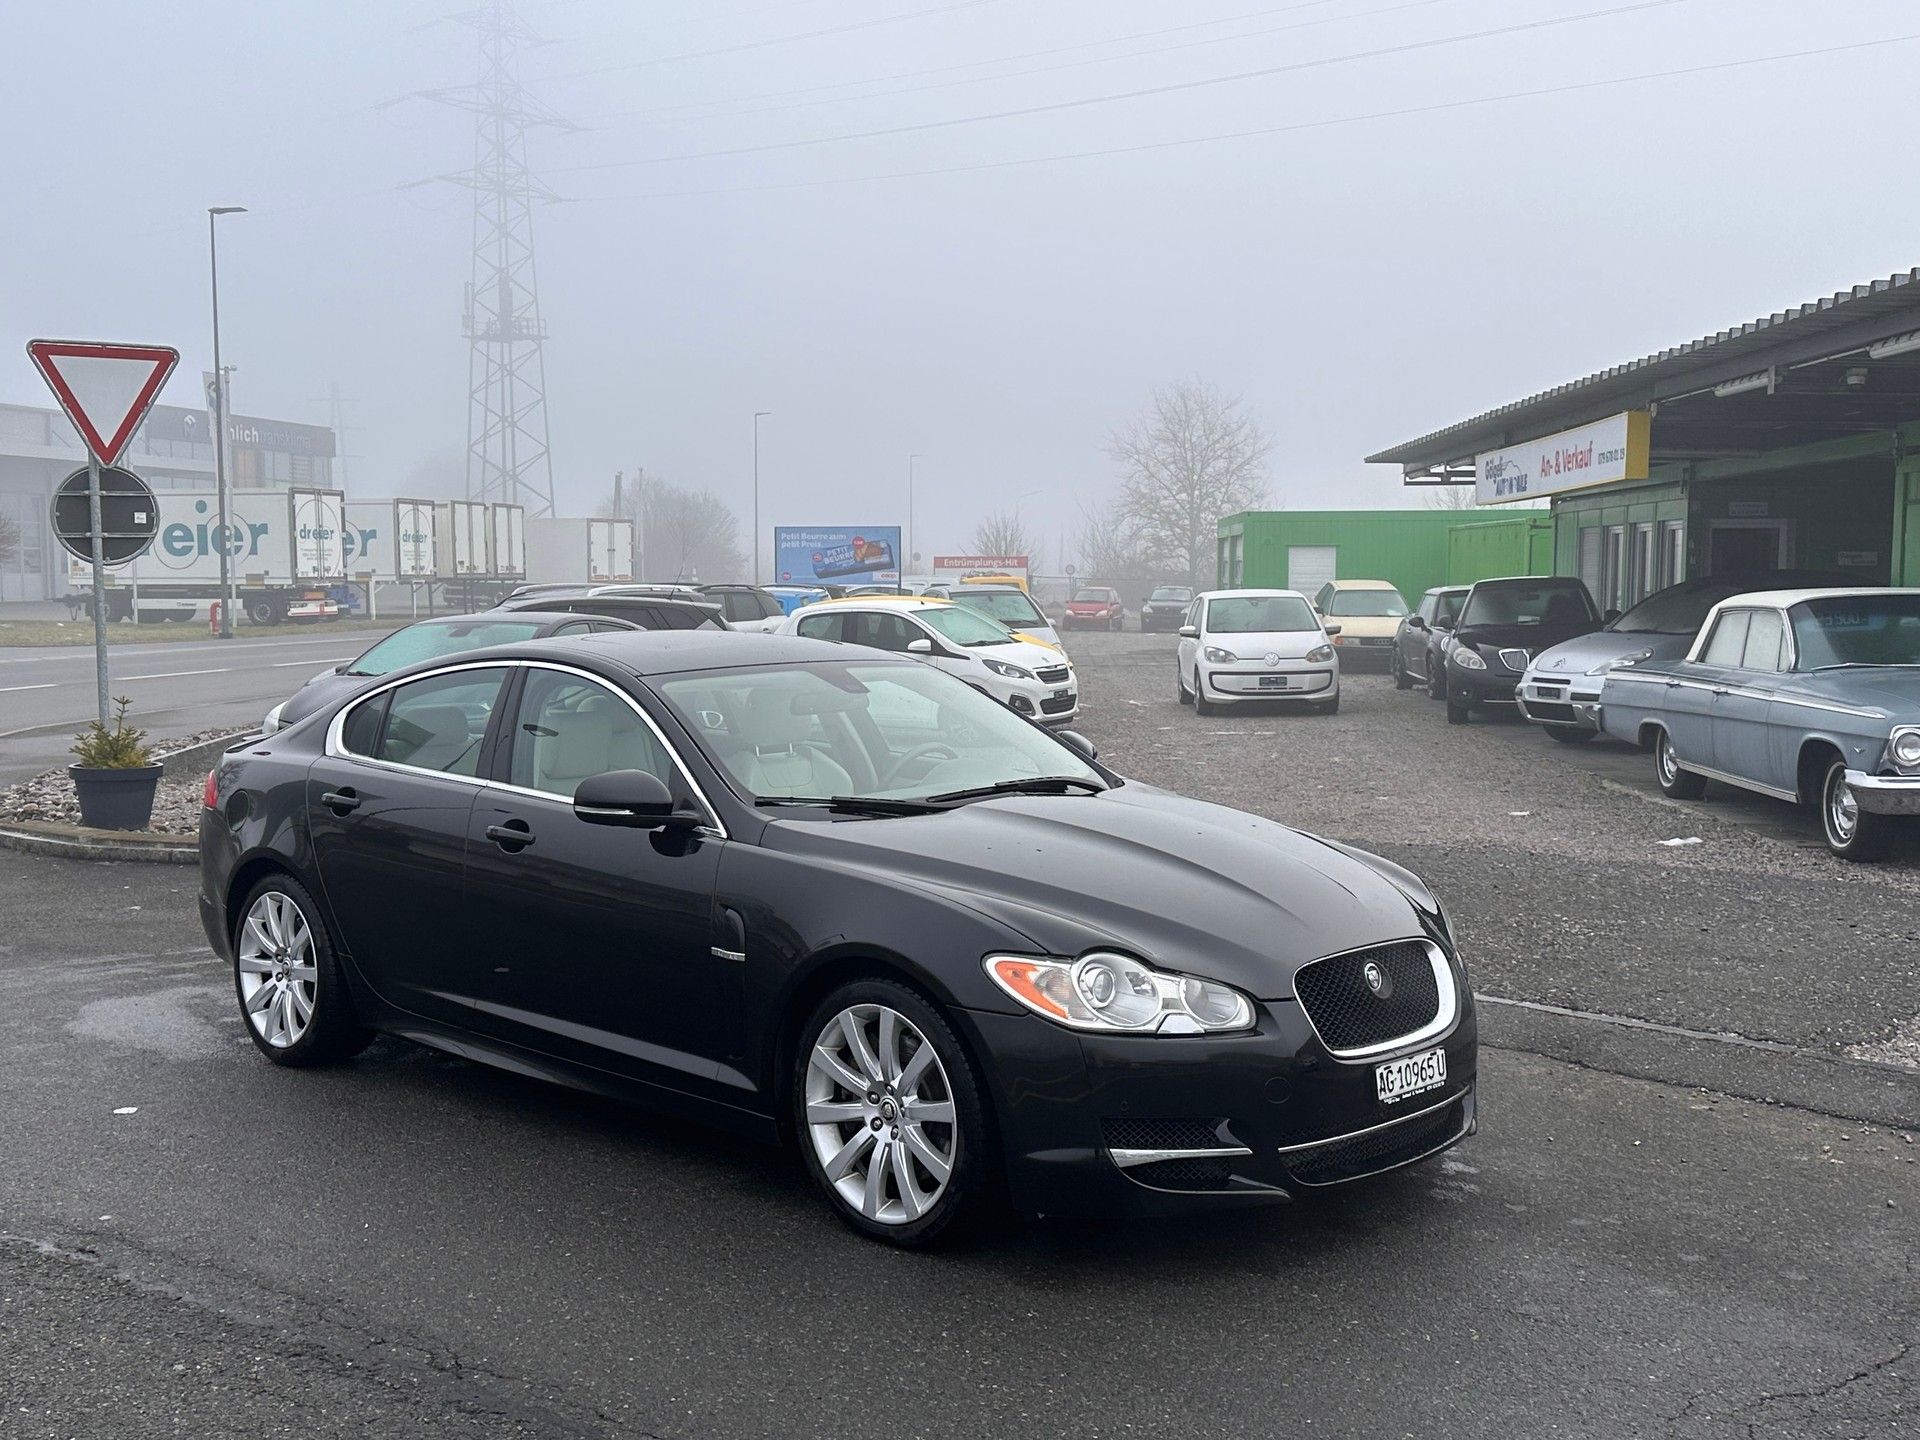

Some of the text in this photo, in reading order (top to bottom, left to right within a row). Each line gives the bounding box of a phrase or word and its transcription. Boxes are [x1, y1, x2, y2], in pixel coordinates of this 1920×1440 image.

[1540, 440, 1594, 477] An- & Verkauf
[300, 523, 335, 540] dreier
[402, 529, 428, 544] dreier
[781, 541, 800, 549] petit
[827, 545, 849, 557] PETIT
[824, 551, 856, 564] BEURRE
[944, 558, 1019, 569] Entrümplungs-Hit
